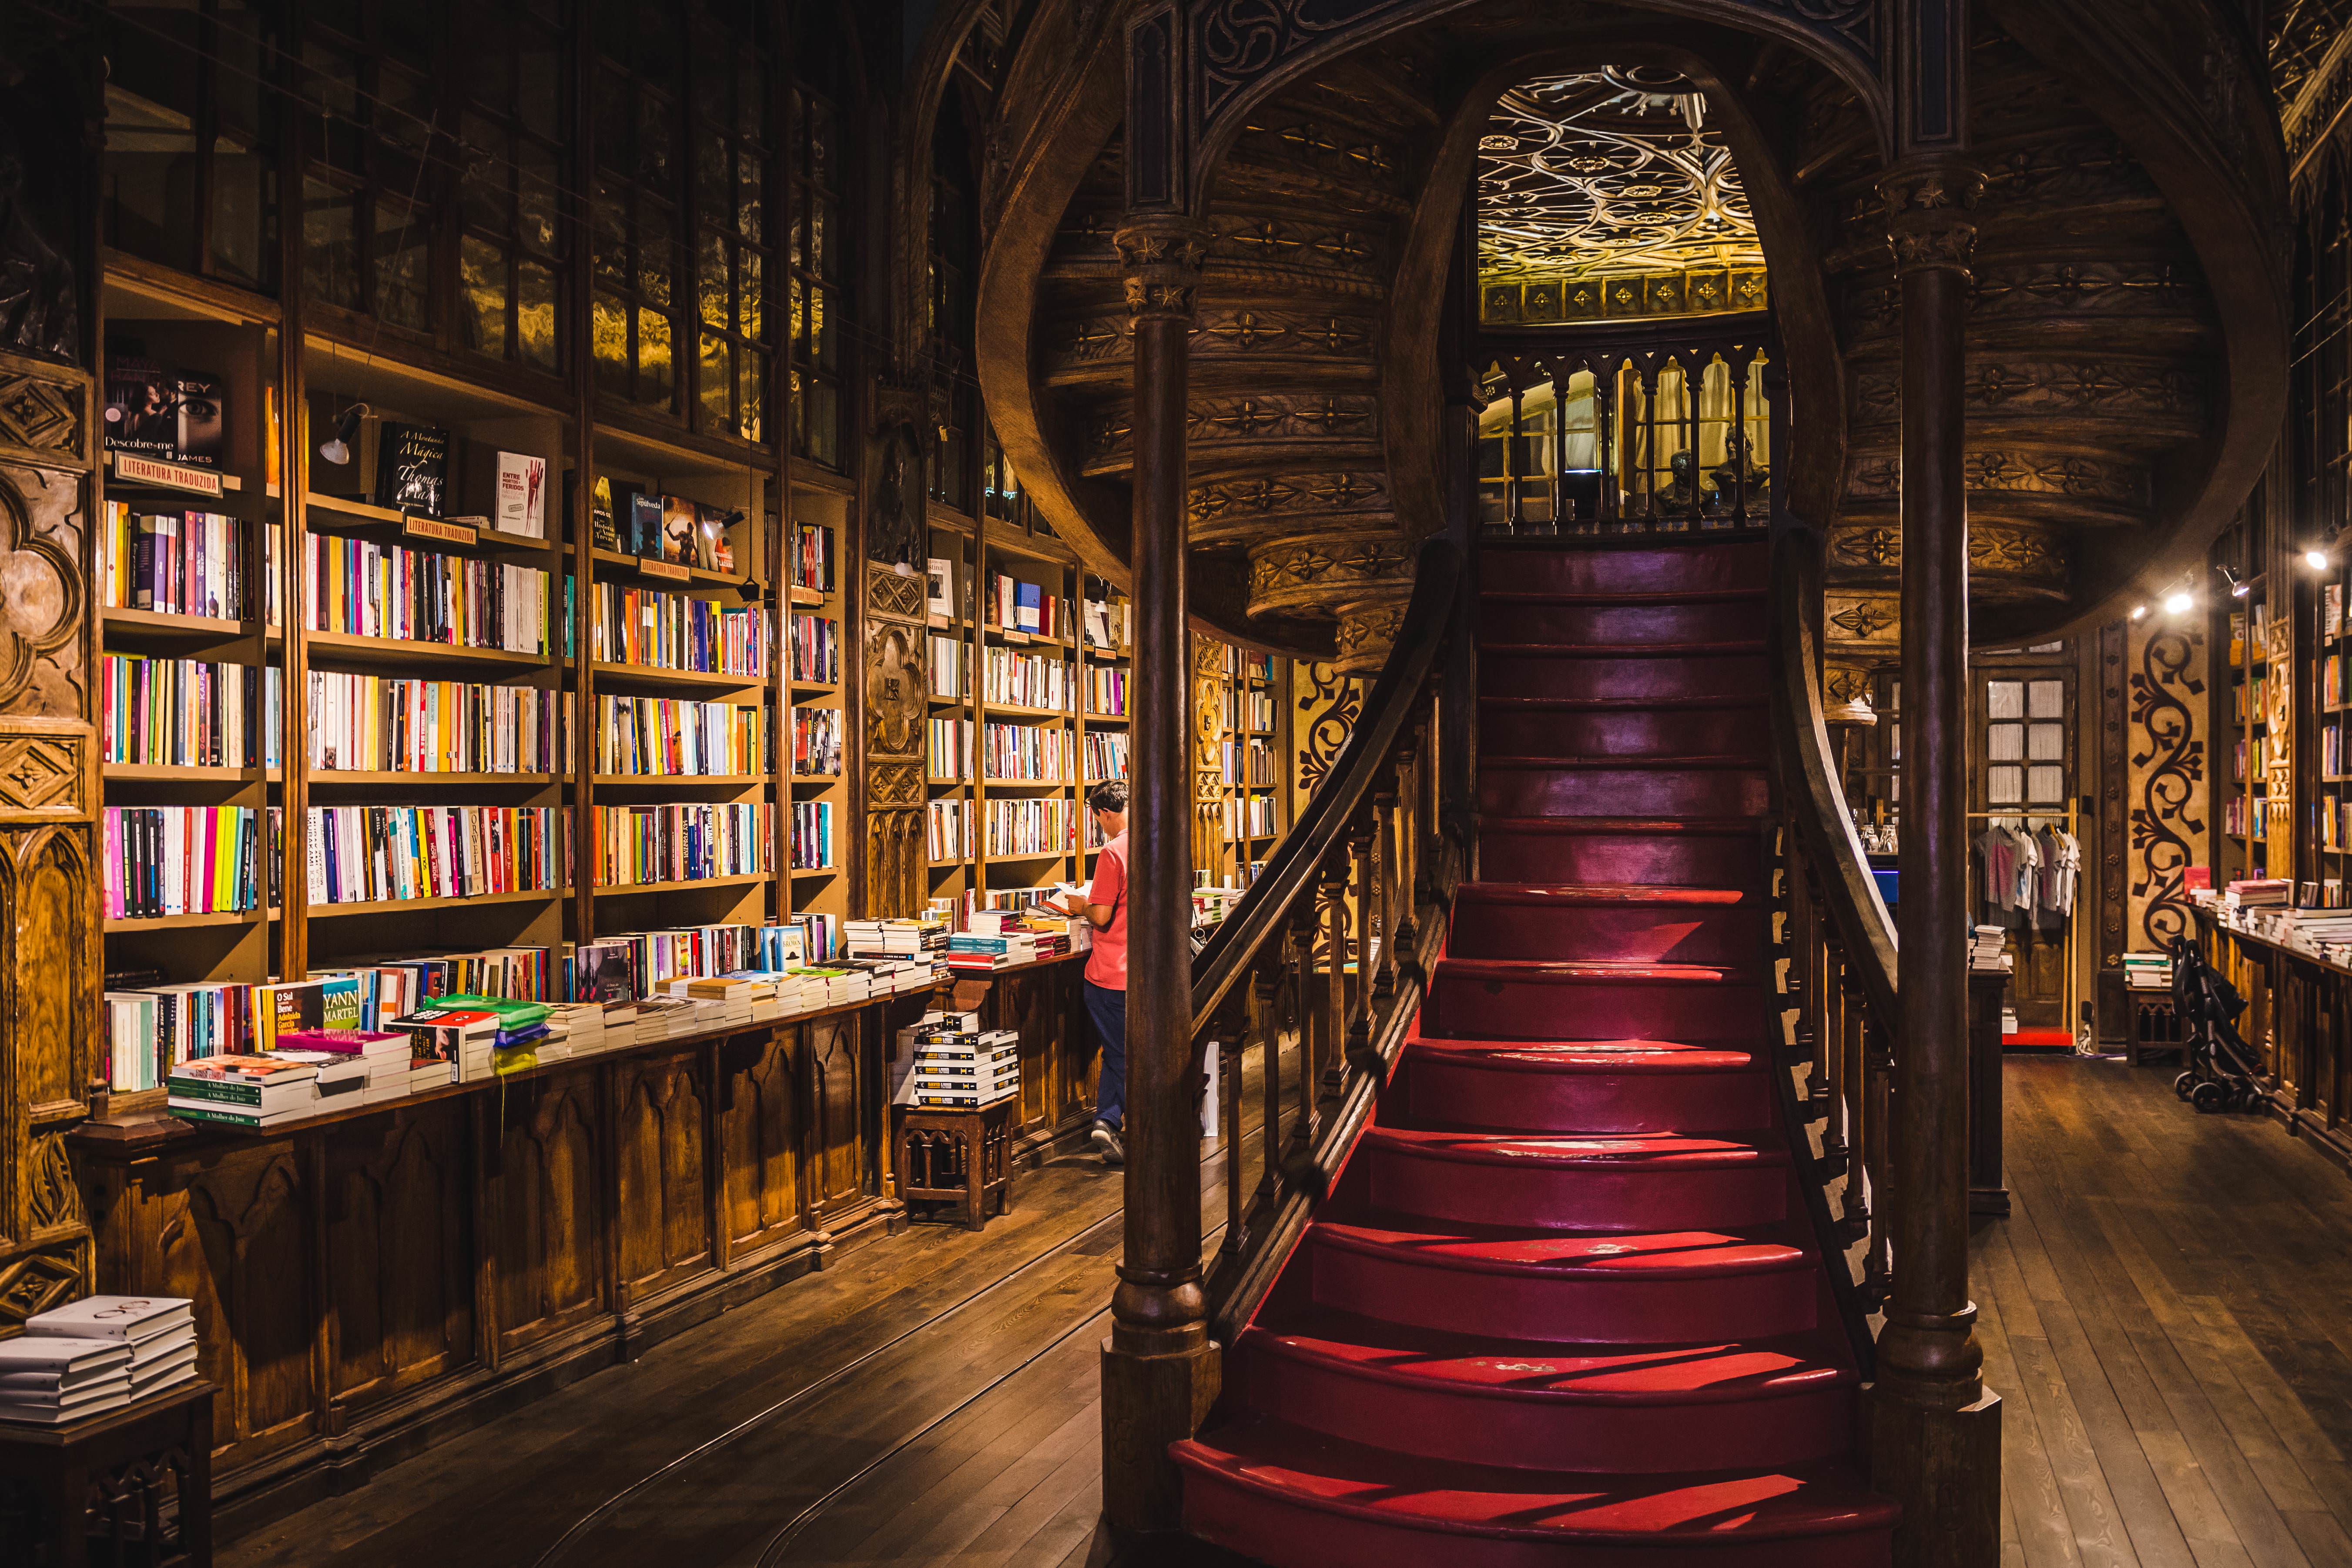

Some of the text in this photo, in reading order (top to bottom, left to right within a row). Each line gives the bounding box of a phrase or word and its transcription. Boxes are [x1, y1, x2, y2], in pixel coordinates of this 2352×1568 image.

[178, 381, 211, 393] REY
[106, 436, 173, 450] Descobre-me
[411, 432, 445, 444] Montanha
[401, 442, 442, 460] Mágica
[124, 459, 216, 490] LITERATURA TRADUZIDA
[398, 460, 443, 486] Thomas
[397, 482, 442, 502] Mann
[637, 499, 660, 509] Sepúlveda
[409, 519, 474, 543] LITERATURA TRADUZIDA
[643, 561, 688, 578] LITERATURA TRADUZIDA
[471, 814, 480, 874] ORWELL
[277, 992, 293, 1002] O Sul
[323, 990, 357, 1009] YANN
[278, 1005, 292, 1013] Bene
[278, 1012, 301, 1021] Adelaida
[324, 1007, 358, 1022] MARTEL
